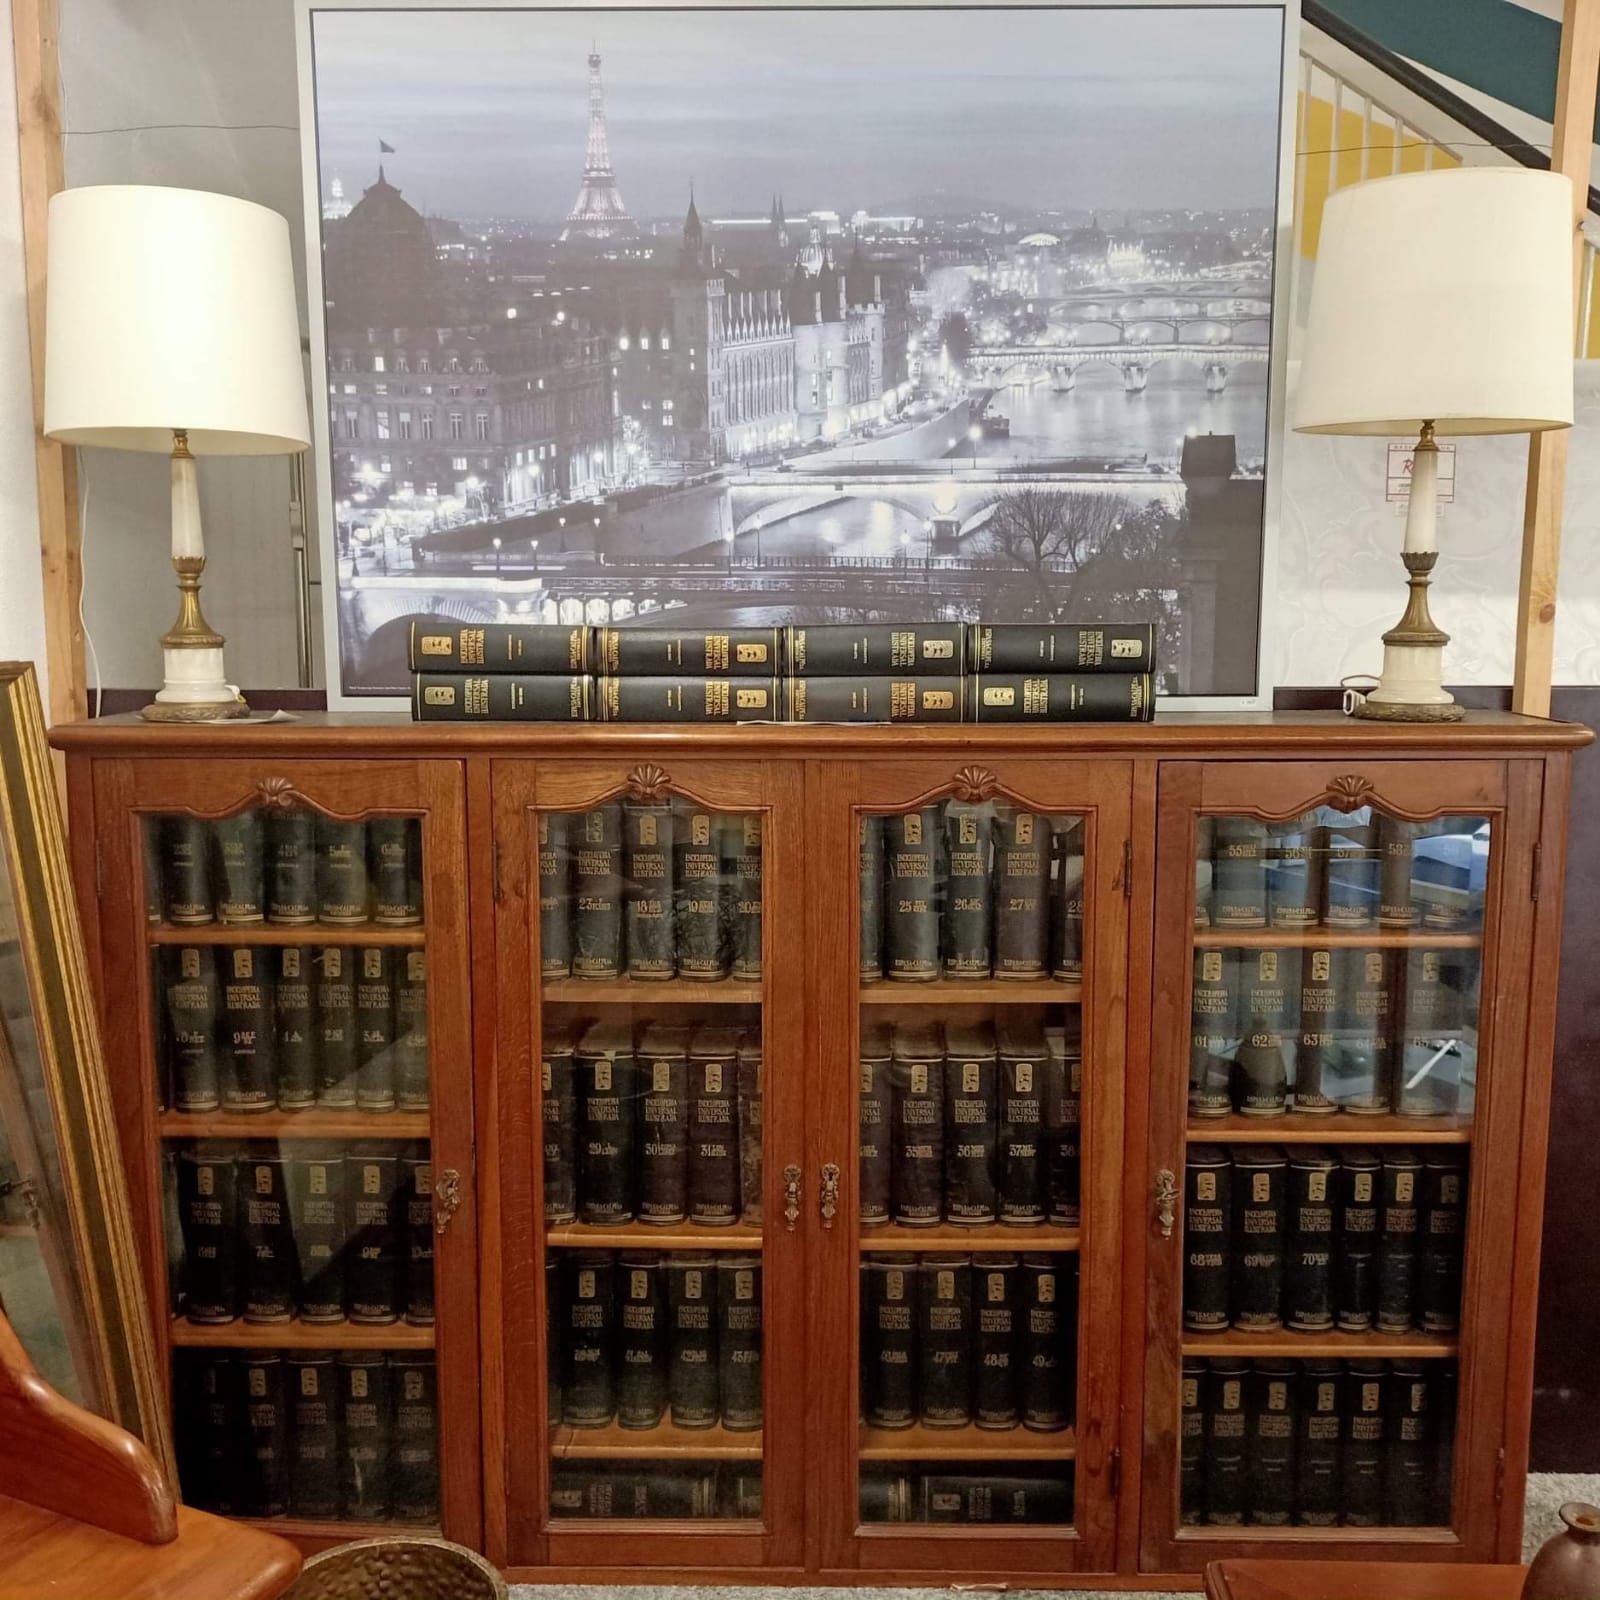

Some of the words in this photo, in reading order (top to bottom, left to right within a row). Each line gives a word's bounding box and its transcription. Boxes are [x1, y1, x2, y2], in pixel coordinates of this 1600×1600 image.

[468, 629, 476, 663] UNIVERSAL
[476, 629, 484, 663] ILUSTRADA
[705, 636, 713, 669] ILUSTRADA
[713, 636, 721, 669] UNIVERSAL
[891, 632, 899, 667] ILUSTRADA
[1078, 631, 1087, 665] ILUSTRADA
[705, 681, 713, 715] ILUSTRADA
[713, 681, 721, 715] UNIVERSAL
[891, 683, 899, 717] ILUSTRADA
[1032, 679, 1040, 713] UNIVERSAL
[1040, 679, 1048, 713] ILUSTRADA
